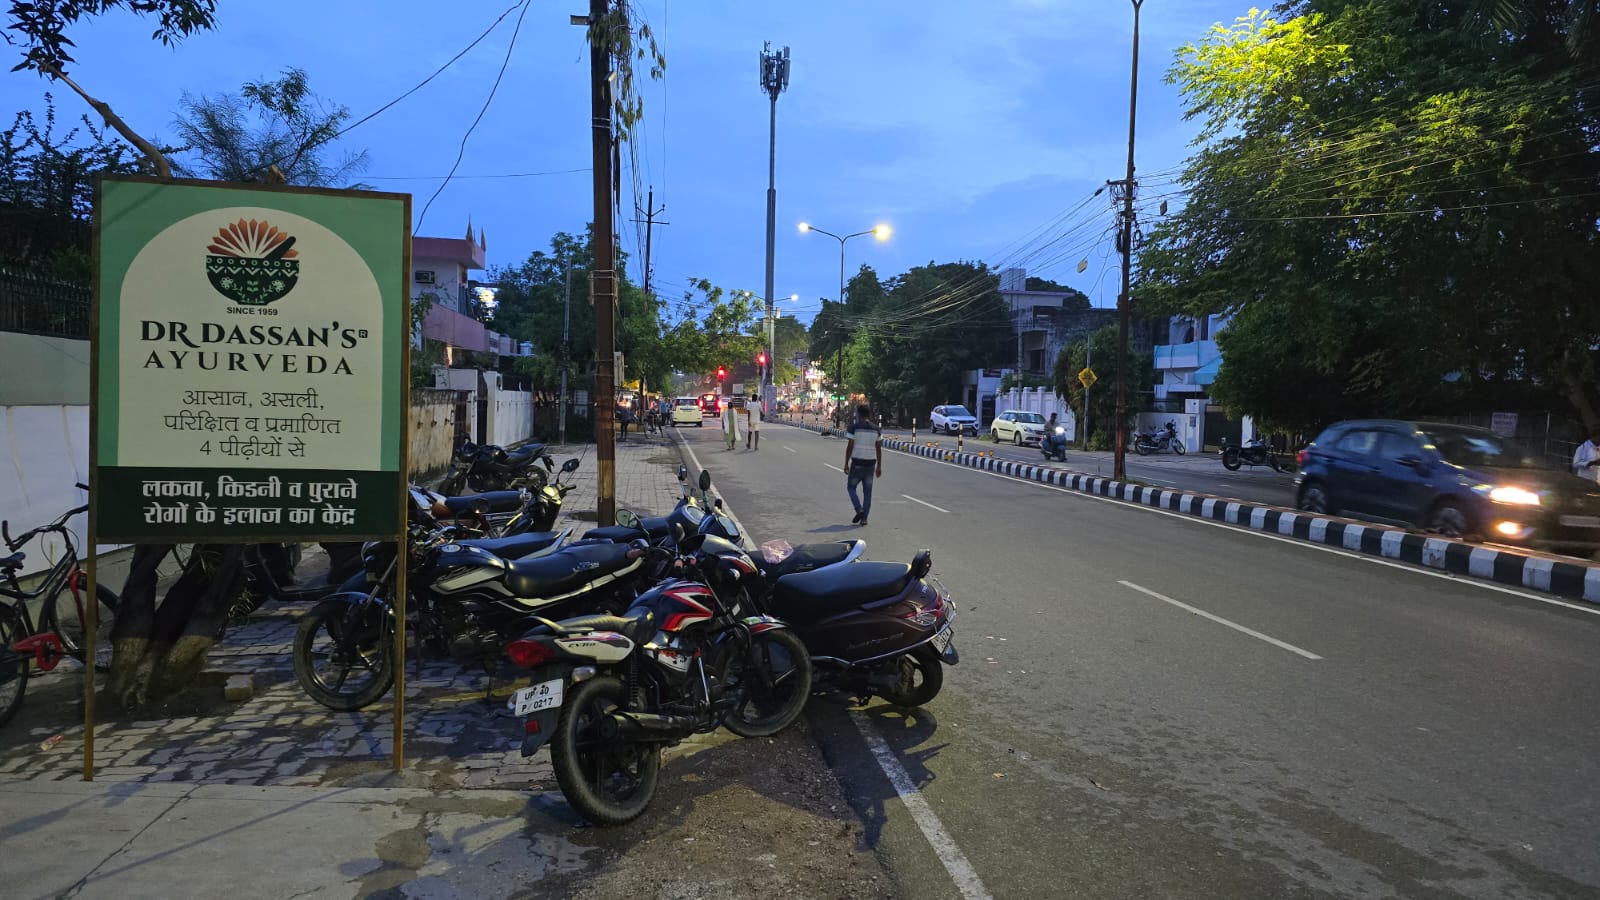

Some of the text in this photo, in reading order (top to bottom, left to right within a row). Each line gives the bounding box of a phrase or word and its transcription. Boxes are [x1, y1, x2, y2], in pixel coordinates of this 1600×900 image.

[226, 306, 278, 316] SINCE 1959
[143, 349, 353, 375] AYURVEDA
[182, 387, 324, 410] आसान, असली,
[163, 409, 342, 434] परिक्षित व प्रमाणित
[199, 440, 212, 456] 4
[287, 436, 307, 457] से
[141, 475, 358, 503] लकवा, किडनी व पुराने
[143, 502, 356, 526] रोगों के इलाज का केंद्र
[524, 690, 535, 700] UP
